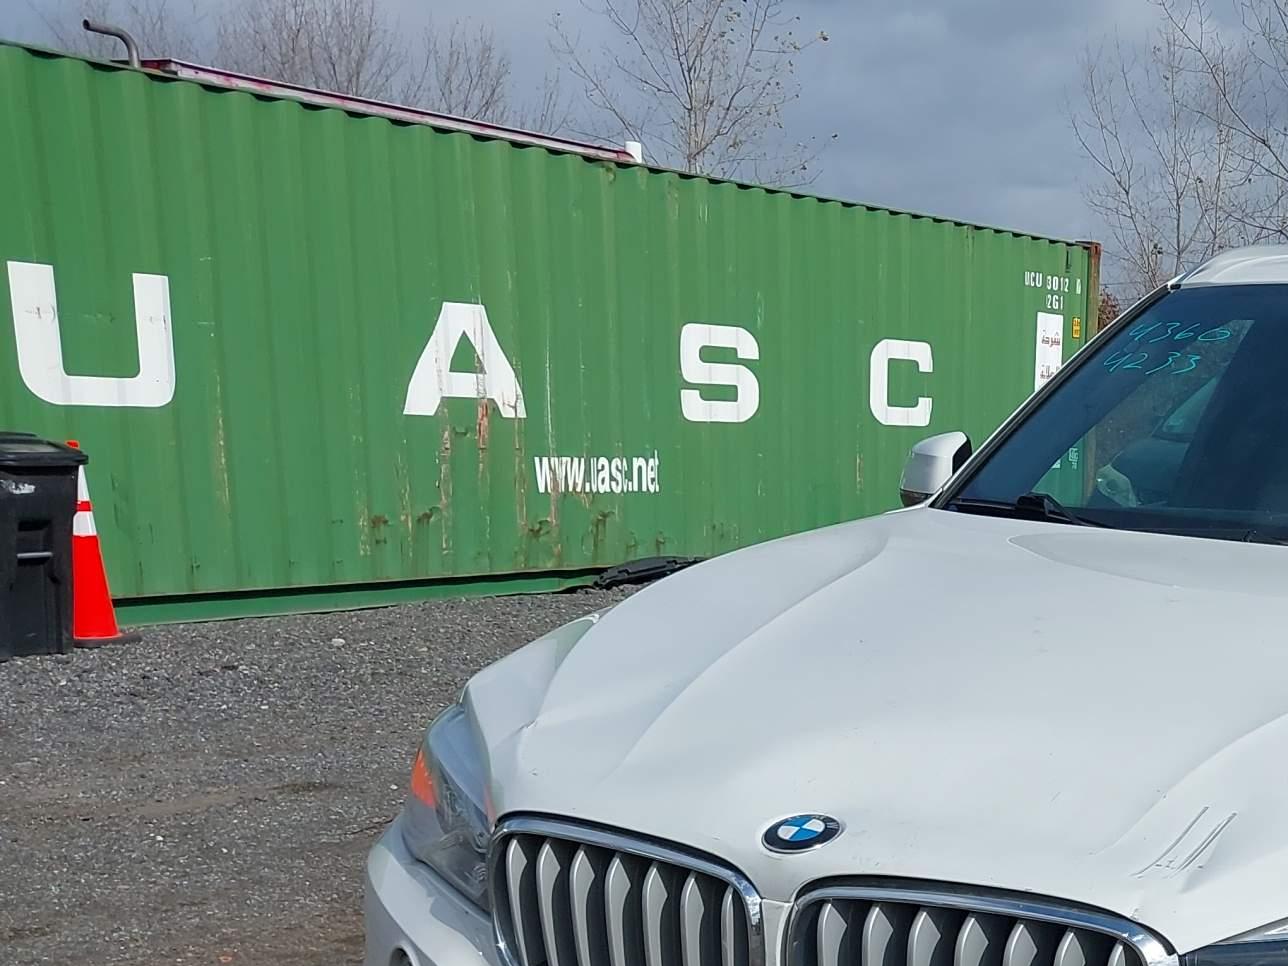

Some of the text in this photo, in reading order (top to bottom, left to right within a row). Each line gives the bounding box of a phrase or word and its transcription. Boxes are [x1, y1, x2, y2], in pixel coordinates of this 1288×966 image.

[1129, 322, 1231, 342] 4360
[1104, 352, 1201, 374] 4233
[534, 449, 659, 493] www.uasc.net
